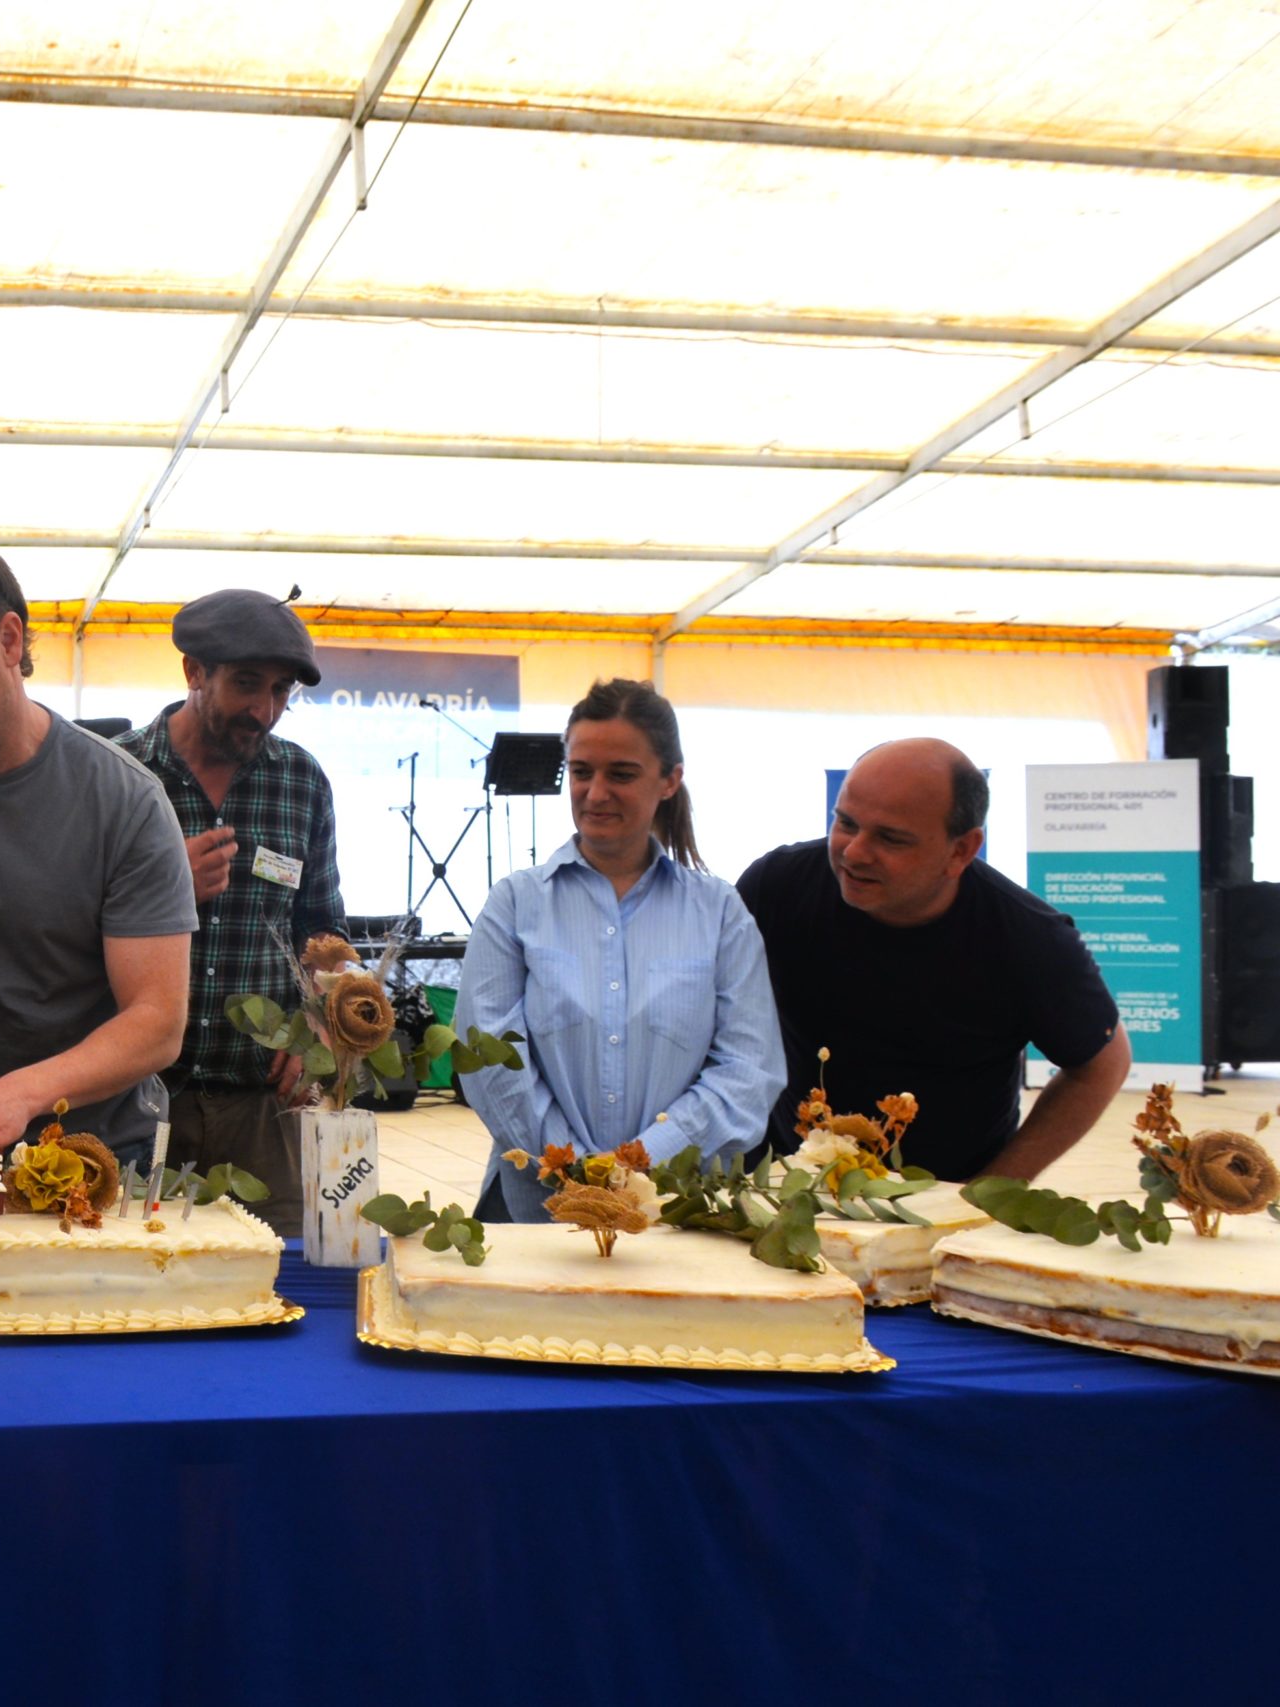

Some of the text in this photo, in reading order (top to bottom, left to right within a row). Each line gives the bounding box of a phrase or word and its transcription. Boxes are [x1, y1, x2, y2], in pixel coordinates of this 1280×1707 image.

[331, 688, 494, 716] OLAVARRÍA
[1044, 789, 1177, 801] CENTRO DE FORMACIÓN
[1044, 802, 1120, 812] PROFESIONAL
[1044, 821, 1107, 832] OLAVARRÍA
[1045, 871, 1167, 882] DIRECCIÓN PROVINCIAL
[1045, 882, 1124, 893] DE EDUCACIÓN
[1045, 893, 1166, 904] TÉCNICO PROFESIONAL
[1102, 933, 1150, 942] GENERAL
[1110, 944, 1118, 952] Y
[1119, 943, 1180, 953] EDUCACIÓN
[1119, 1007, 1180, 1020] BUENOS
[322, 1157, 374, 1209] Sueña
